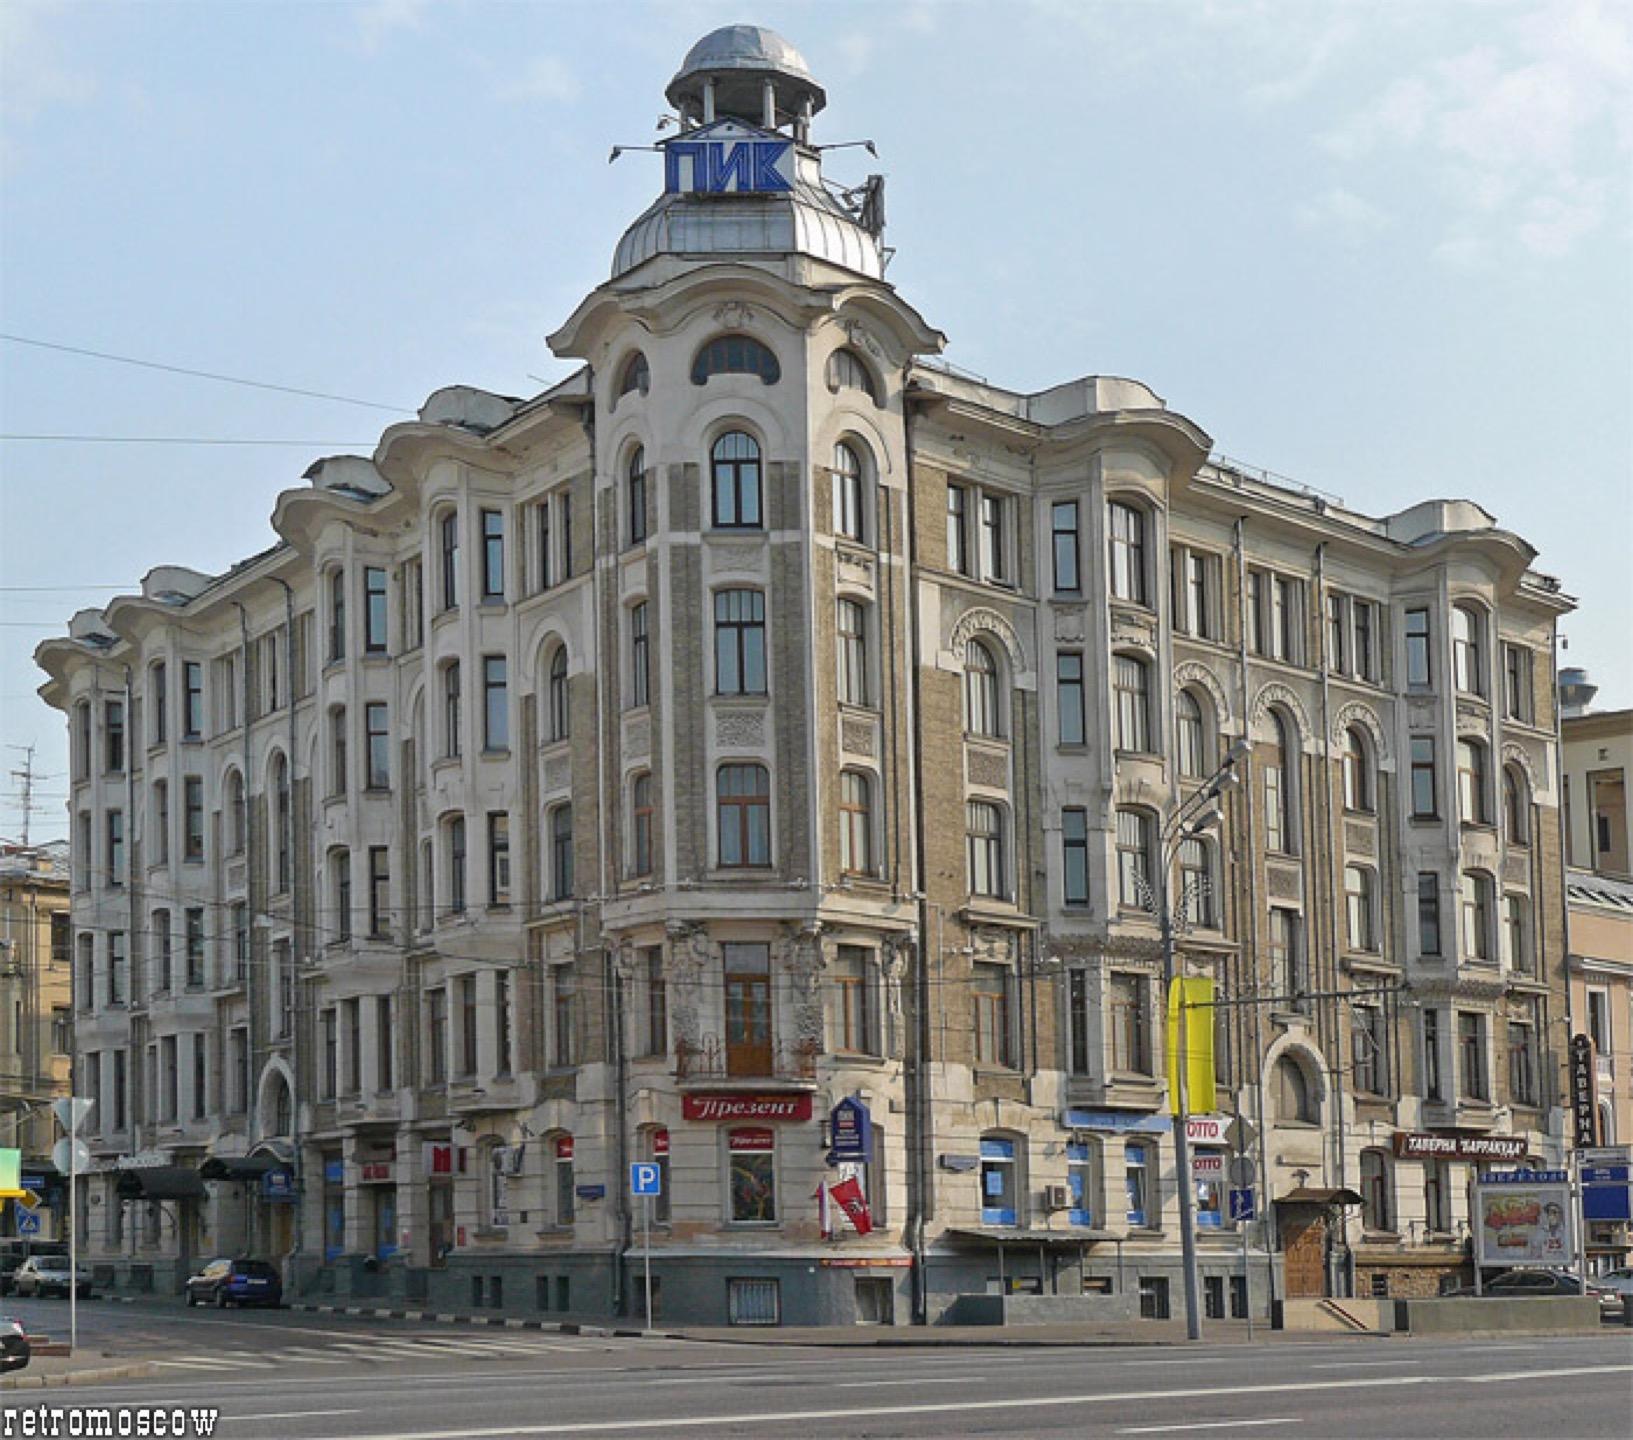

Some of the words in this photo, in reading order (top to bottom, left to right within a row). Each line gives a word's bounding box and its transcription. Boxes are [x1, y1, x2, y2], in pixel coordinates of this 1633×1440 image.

[665, 142, 793, 193] ПИК
[1187, 1122, 1219, 1137] OTTO
[1193, 1159, 1221, 1170] OTTO
[638, 1166, 656, 1191] P
